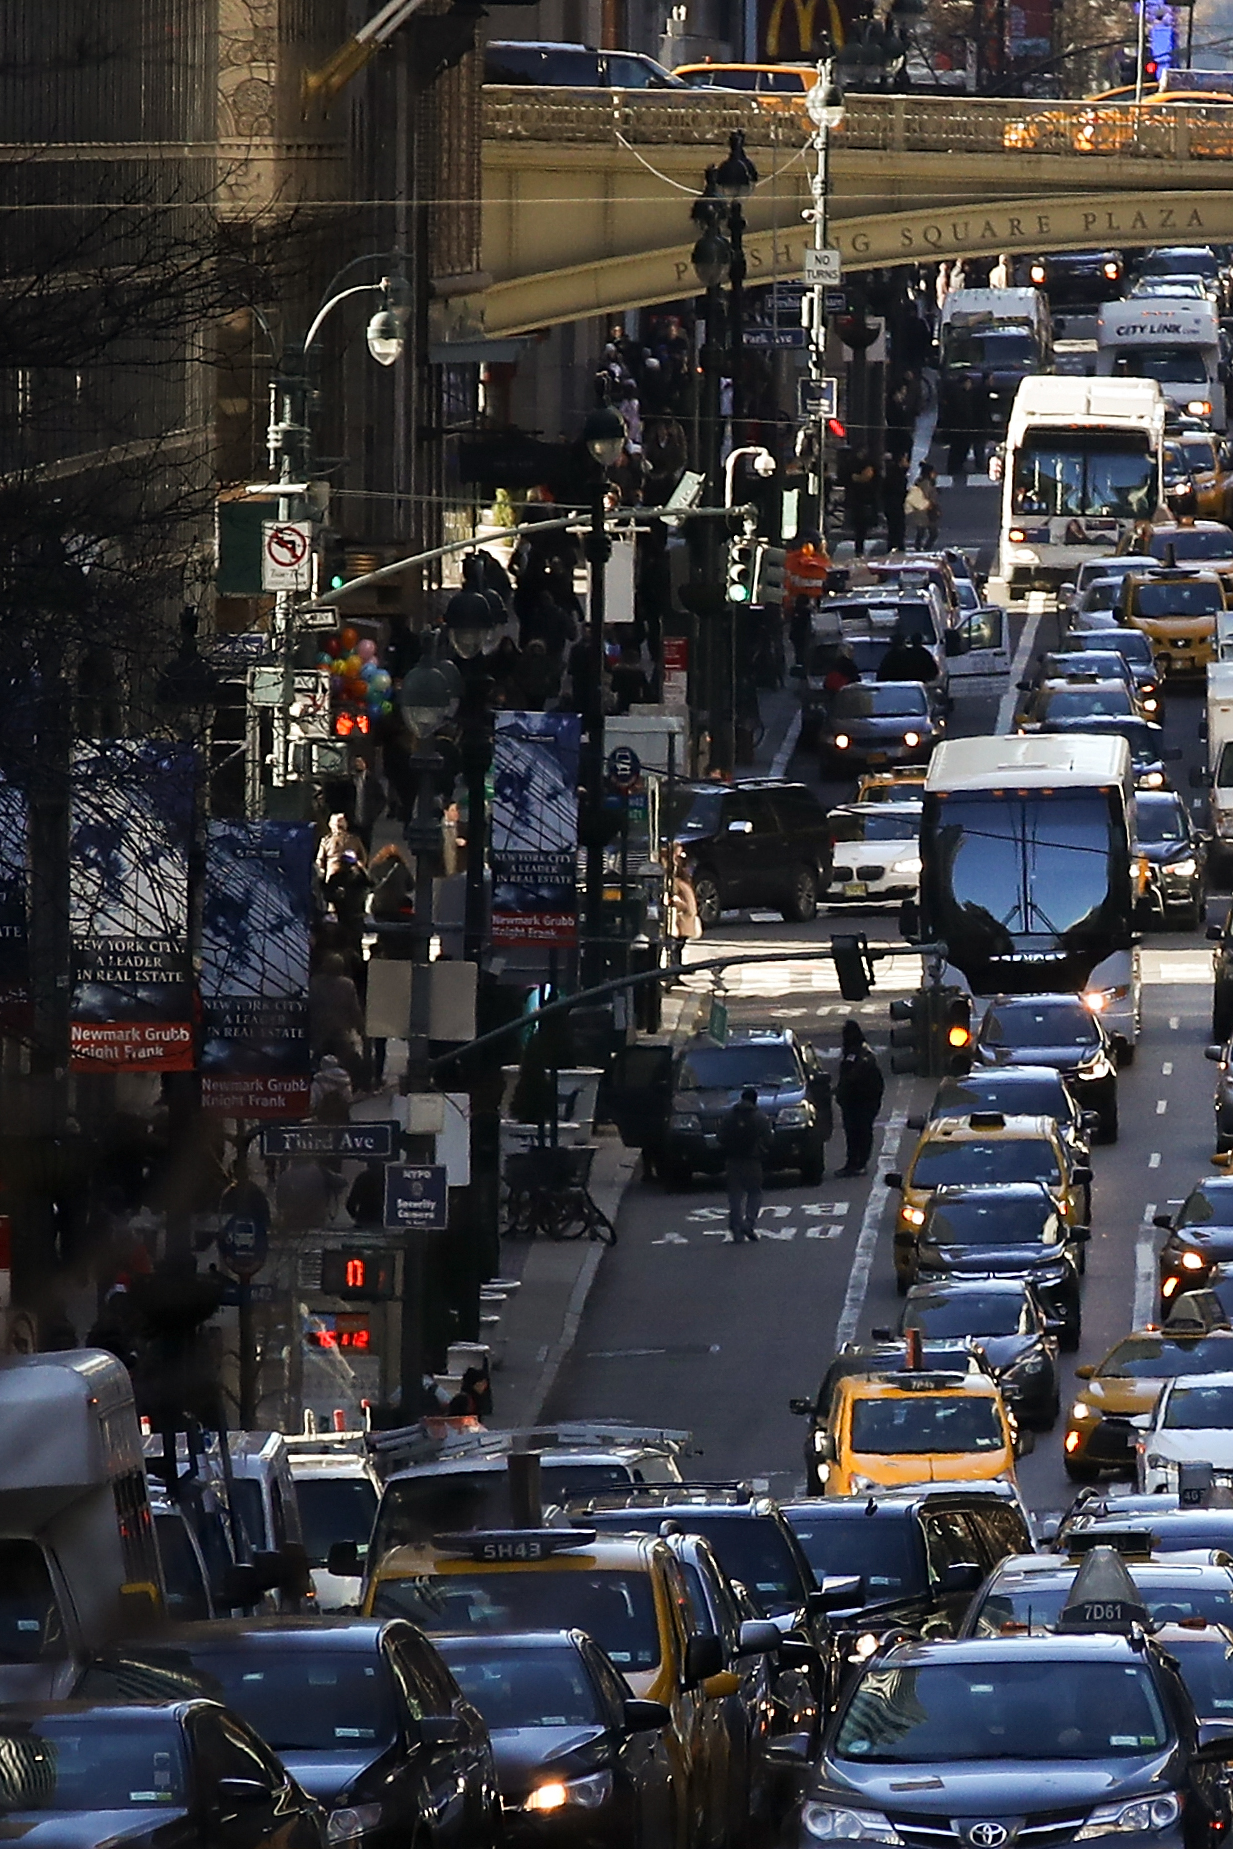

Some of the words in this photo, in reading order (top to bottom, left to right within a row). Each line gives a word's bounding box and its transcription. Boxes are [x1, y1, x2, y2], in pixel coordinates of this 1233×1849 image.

[674, 233, 869, 281] PSHING
[900, 214, 1051, 248] SQUARE
[1082, 207, 1205, 232] PLAZA
[814, 254, 830, 265] NO
[806, 269, 839, 279] TURNS
[1116, 325, 1147, 336] CITY
[511, 864, 517, 873] A
[496, 874, 508, 882] IN
[509, 875, 534, 883] REAL
[537, 875, 573, 884] ESTATE
[491, 914, 540, 925] Newmark
[543, 915, 575, 926] Grubb
[73, 939, 102, 950] NEW
[107, 940, 145, 952] YORK
[97, 956, 104, 966] A
[108, 956, 162, 967] LEADER
[77, 969, 93, 980] IN
[96, 970, 131, 981] REAL
[135, 970, 184, 982] ESTATE
[204, 1000, 231, 1010] NEW
[223, 1014, 232, 1024] A
[236, 1014, 286, 1025] LEAR
[71, 1026, 140, 1041] Newmark
[145, 1028, 190, 1041] Grubb
[71, 1044, 119, 1059] Knight
[124, 1045, 164, 1058] Frank
[202, 1078, 264, 1091] Newmark
[268, 1078, 308, 1092] Grubb
[248, 1094, 286, 1108] Frank
[282, 1133, 333, 1149] Third
[339, 1132, 375, 1149] Ave
[1084, 1604, 1122, 1620] 7D61
